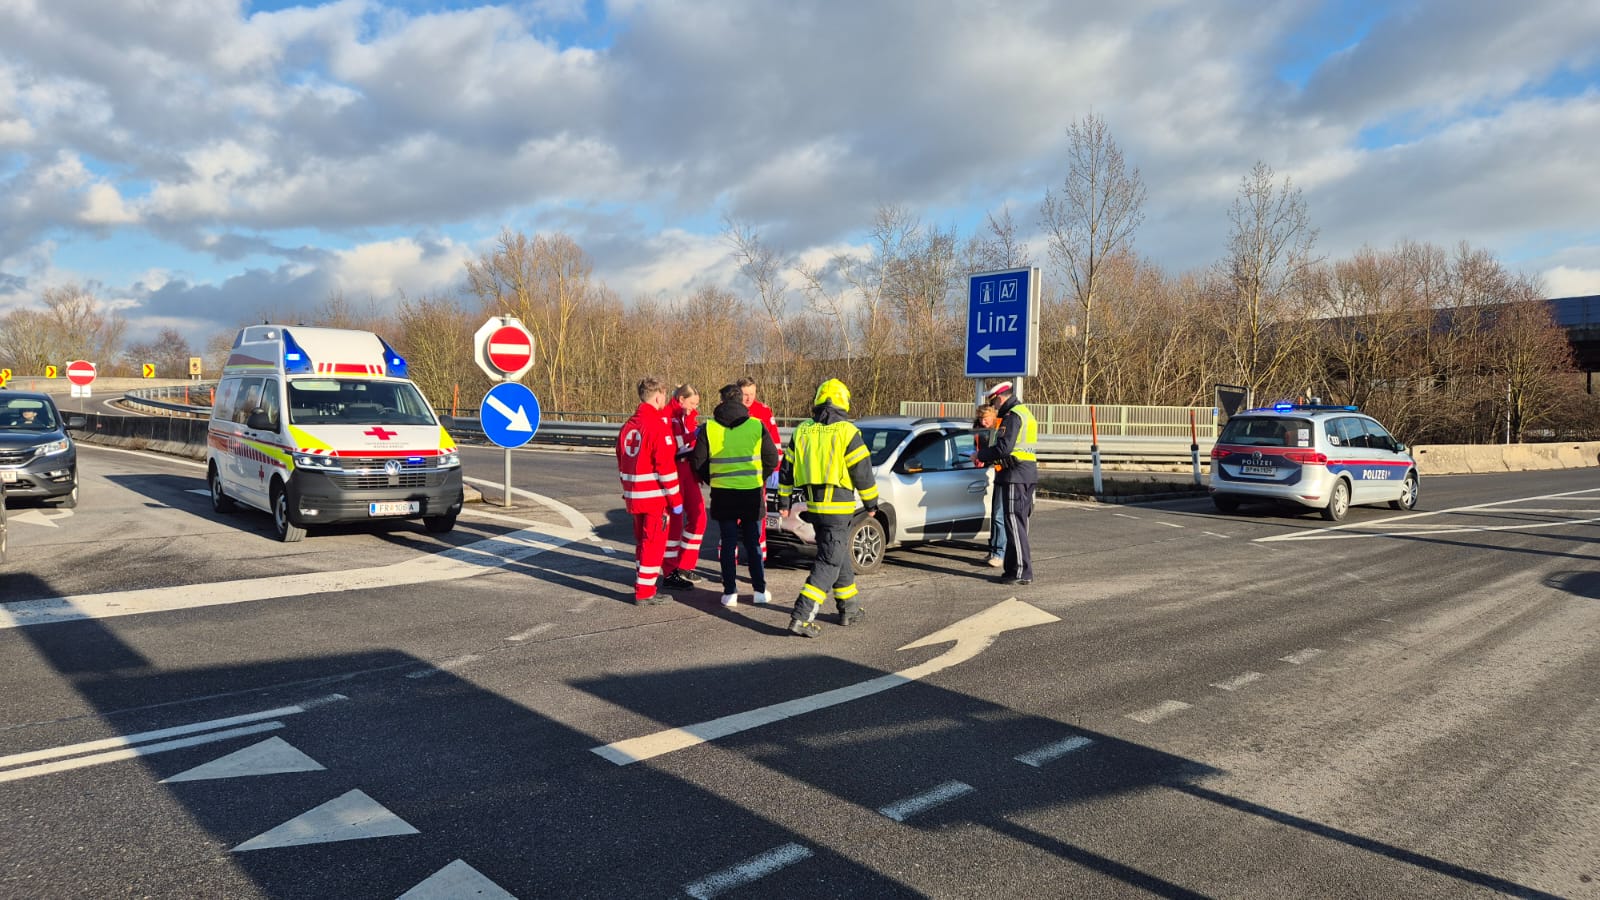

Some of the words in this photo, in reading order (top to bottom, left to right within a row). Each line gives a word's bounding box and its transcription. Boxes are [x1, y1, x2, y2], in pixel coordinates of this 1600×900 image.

[1001, 282, 1016, 299] A7
[976, 311, 1018, 334] Linz
[1362, 469, 1388, 480] POLIZEI
